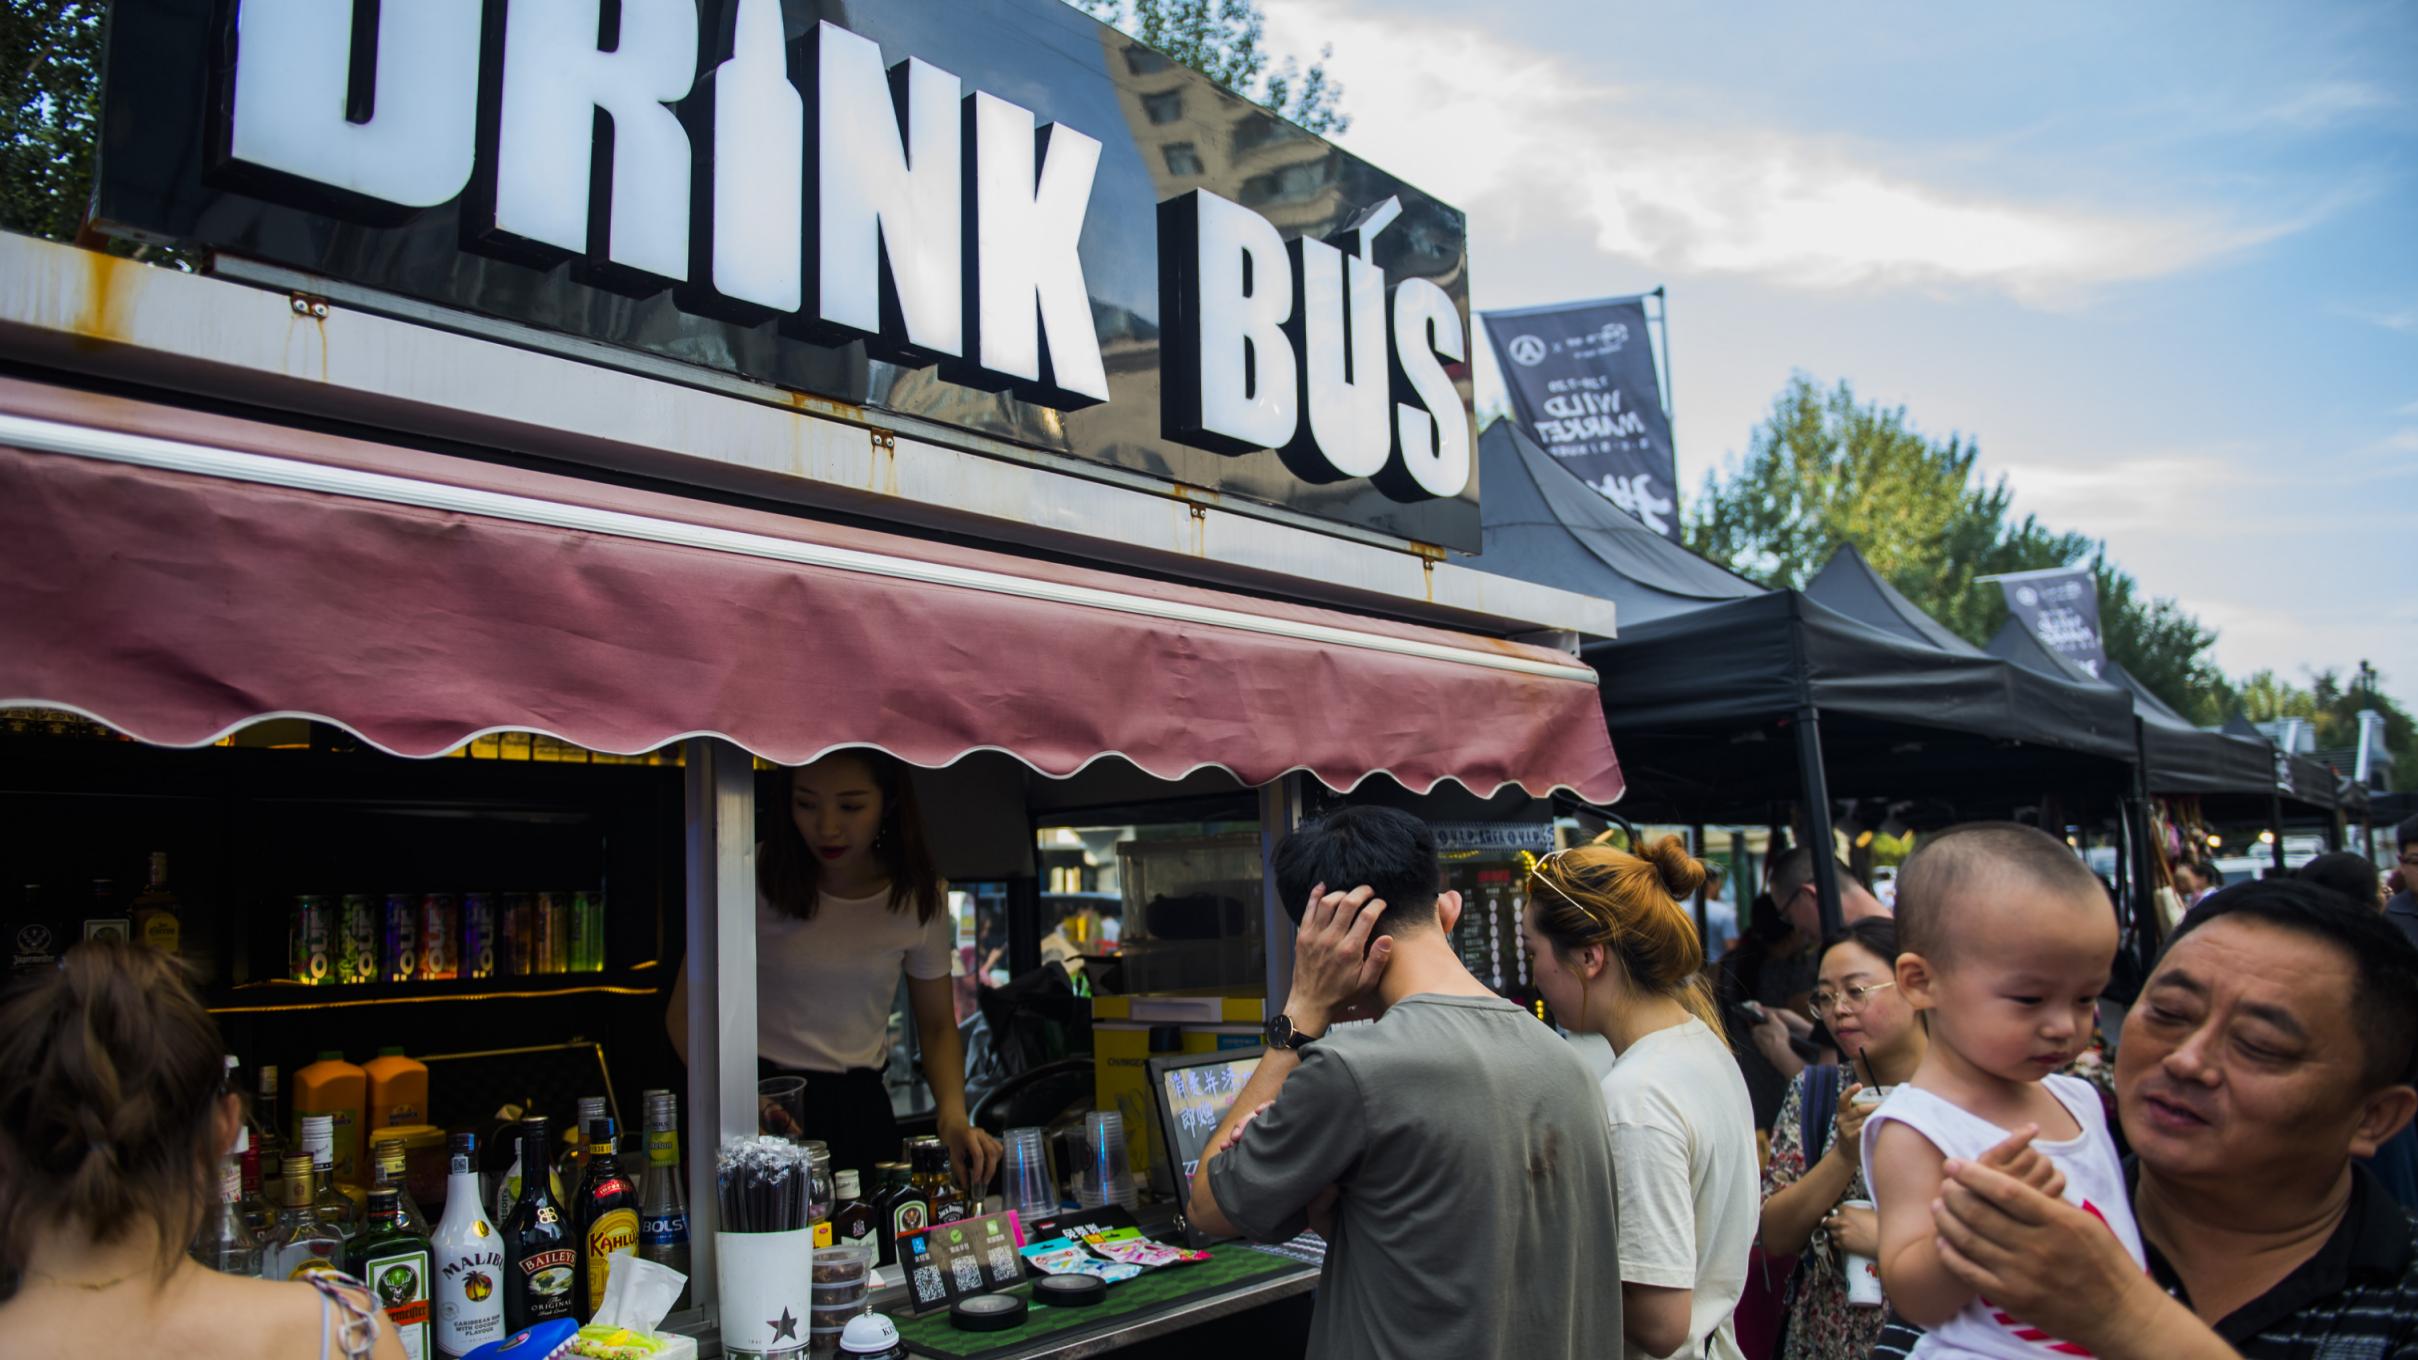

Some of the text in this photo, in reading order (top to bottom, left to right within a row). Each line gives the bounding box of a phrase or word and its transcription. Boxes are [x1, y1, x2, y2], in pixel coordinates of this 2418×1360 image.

[231, 0, 1471, 498] DRINK BUS
[642, 1219, 683, 1233] BOLS
[525, 1251, 576, 1271] BAILEYS
[531, 1299, 573, 1312] ORIGINAL
